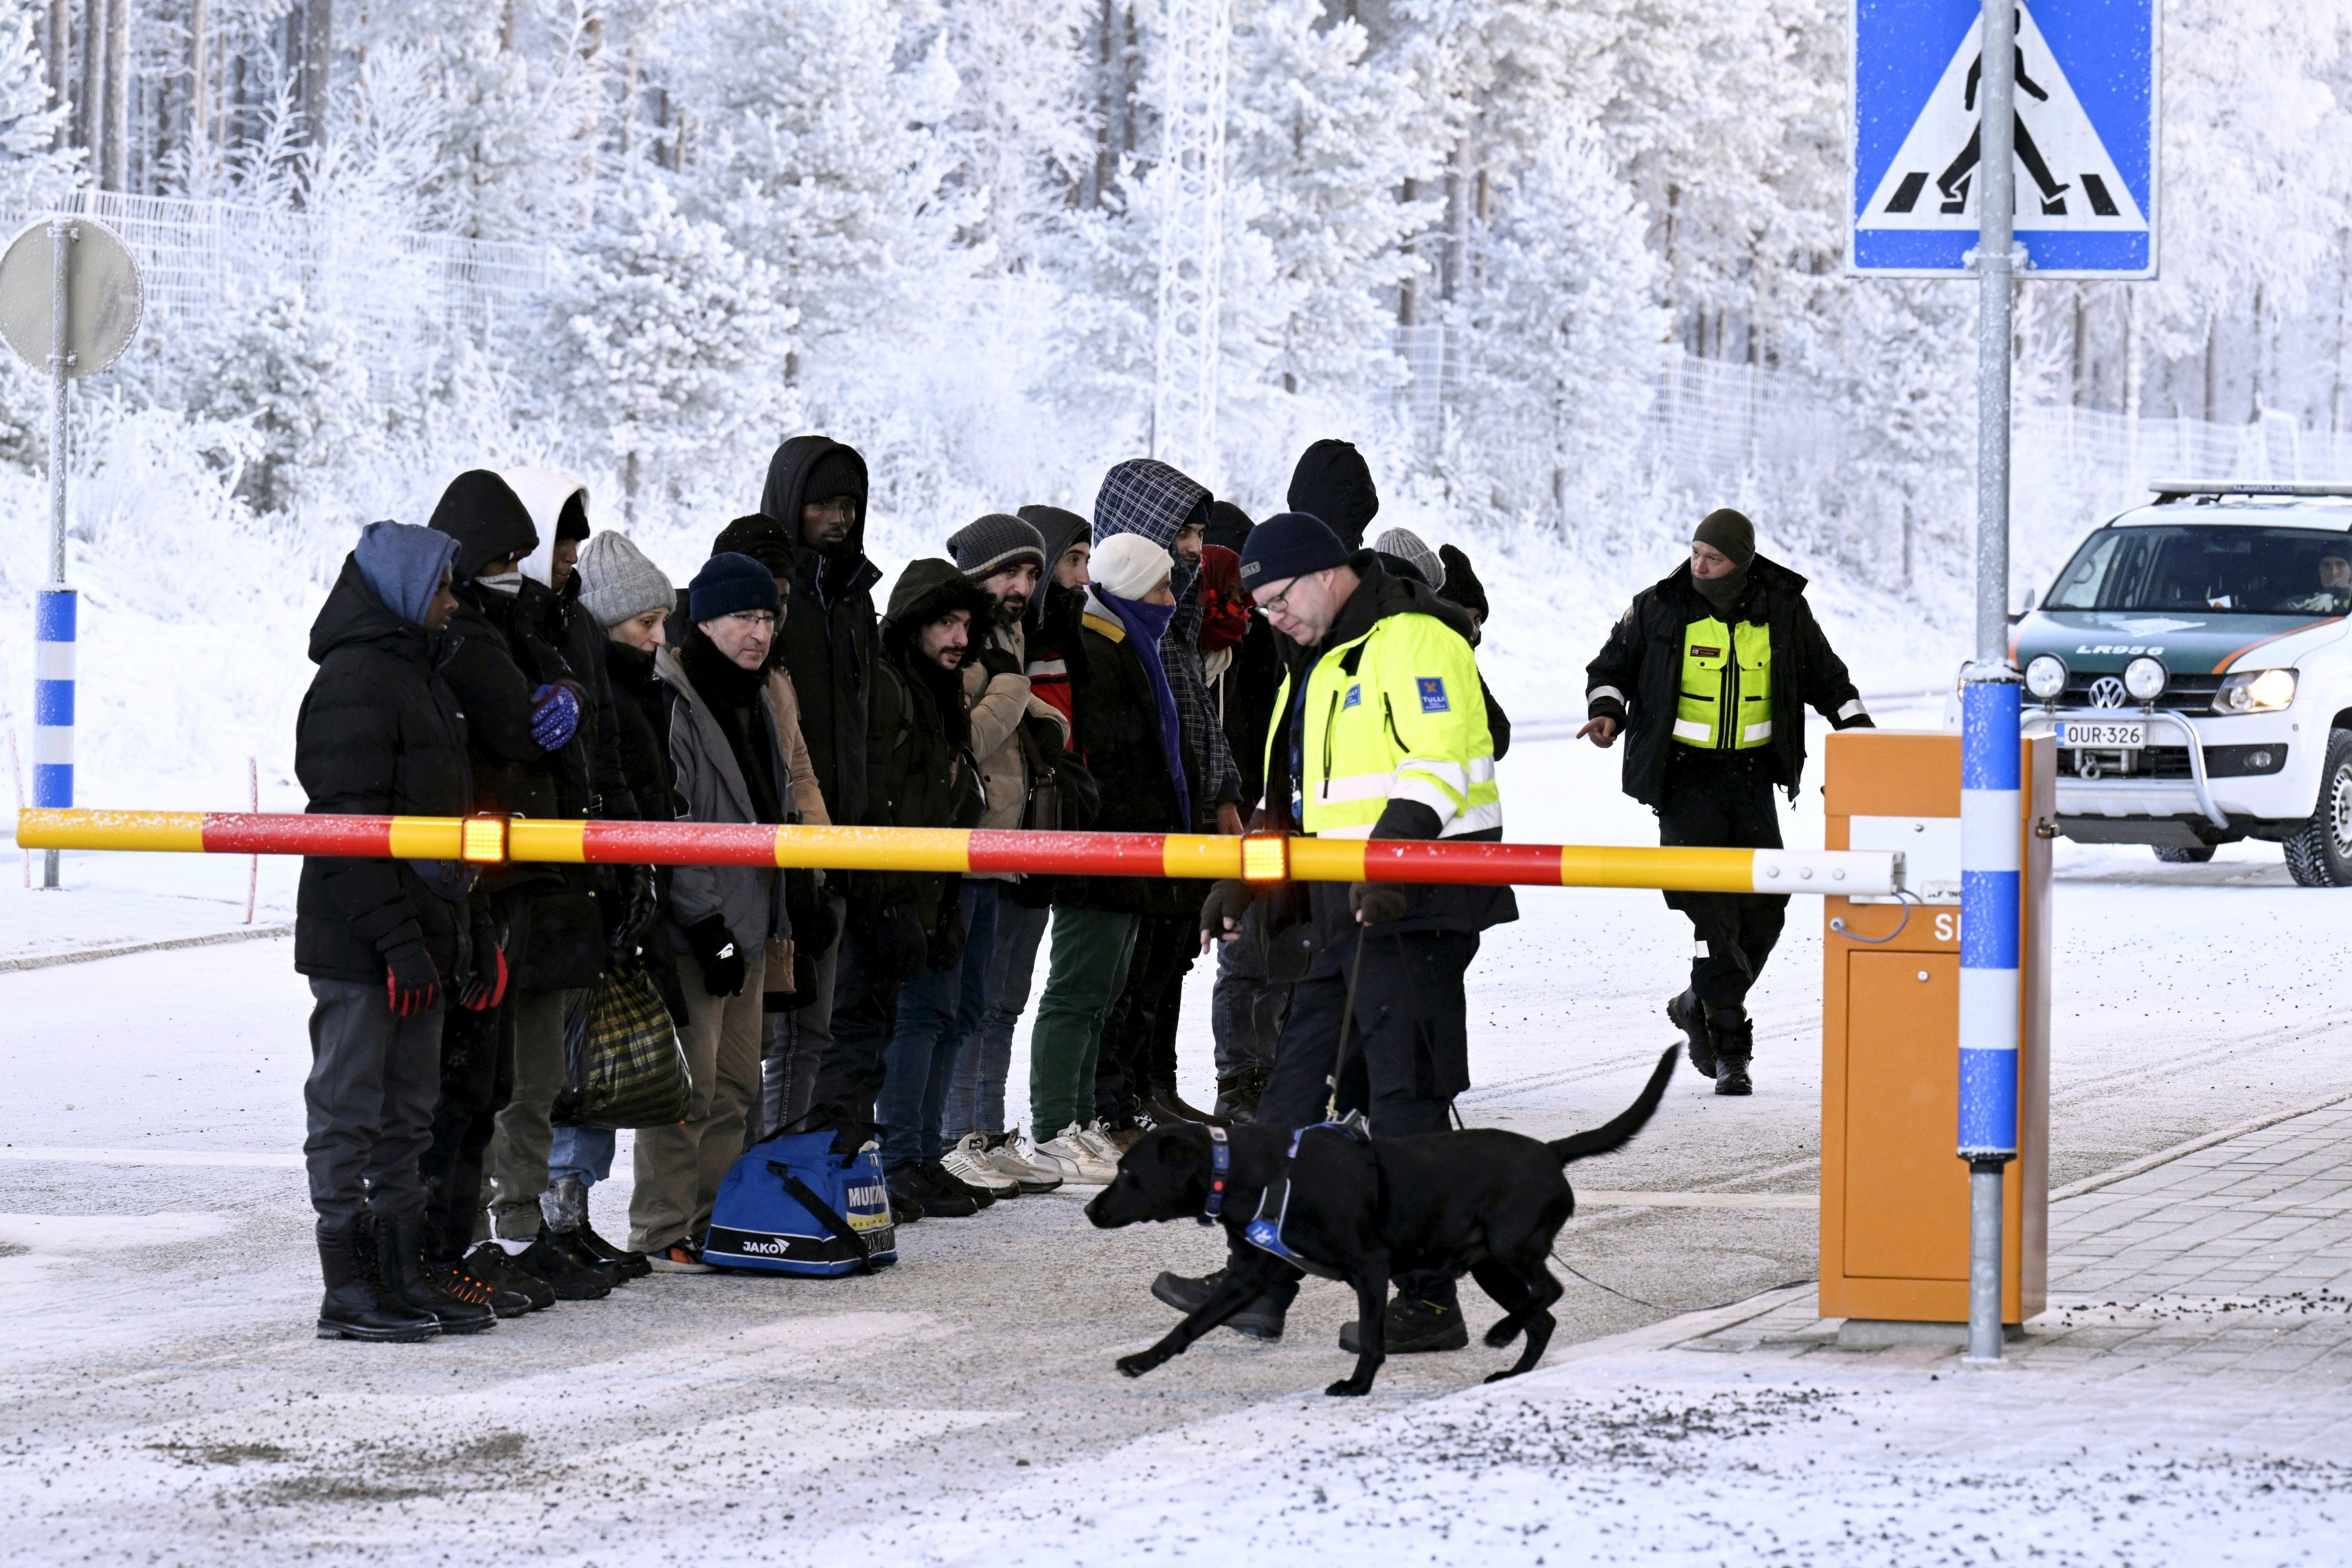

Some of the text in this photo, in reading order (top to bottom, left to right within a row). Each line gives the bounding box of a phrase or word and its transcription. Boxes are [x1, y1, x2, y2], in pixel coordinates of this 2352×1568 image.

[2076, 645, 2165, 655] LR956
[2069, 727, 2139, 743] OUR-326
[743, 1241, 779, 1254] JAKO
